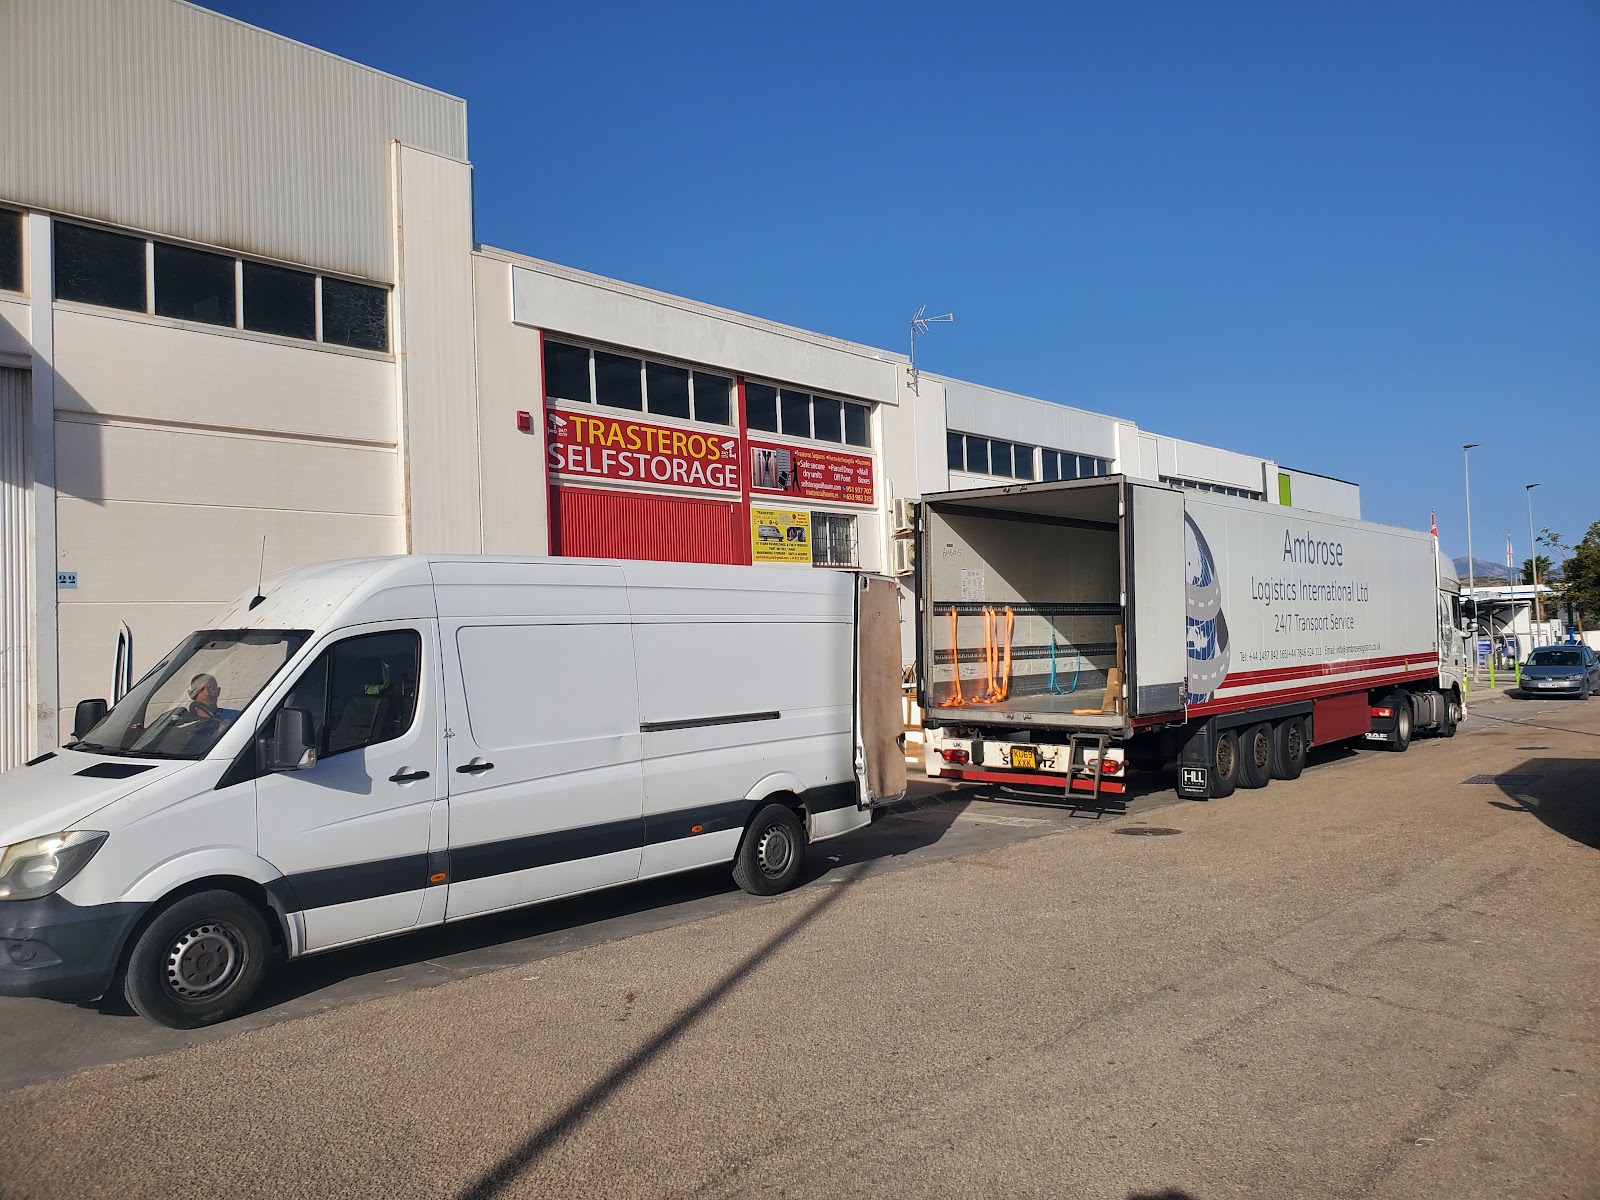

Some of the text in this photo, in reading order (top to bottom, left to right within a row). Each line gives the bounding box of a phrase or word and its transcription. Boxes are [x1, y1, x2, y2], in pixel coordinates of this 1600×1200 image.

[569, 415, 721, 461] TRASTEROS
[812, 452, 825, 460] Seguros
[548, 442, 738, 488] SELFSTORAGE
[800, 460, 810, 468] Safe
[803, 469, 811, 479] dry
[831, 464, 853, 475] Parcel Drop
[859, 468, 868, 476] Mail
[841, 474, 851, 483] Point
[858, 476, 870, 484] Boxes
[1283, 528, 1343, 567] Ambrose
[59, 574, 76, 584] 22
[1251, 576, 1369, 607] Logistics International Ltd
[1274, 613, 1355, 635] 24/7 Transport Service
[1239, 651, 1247, 661] Tel:
[1249, 651, 1258, 661] +44
